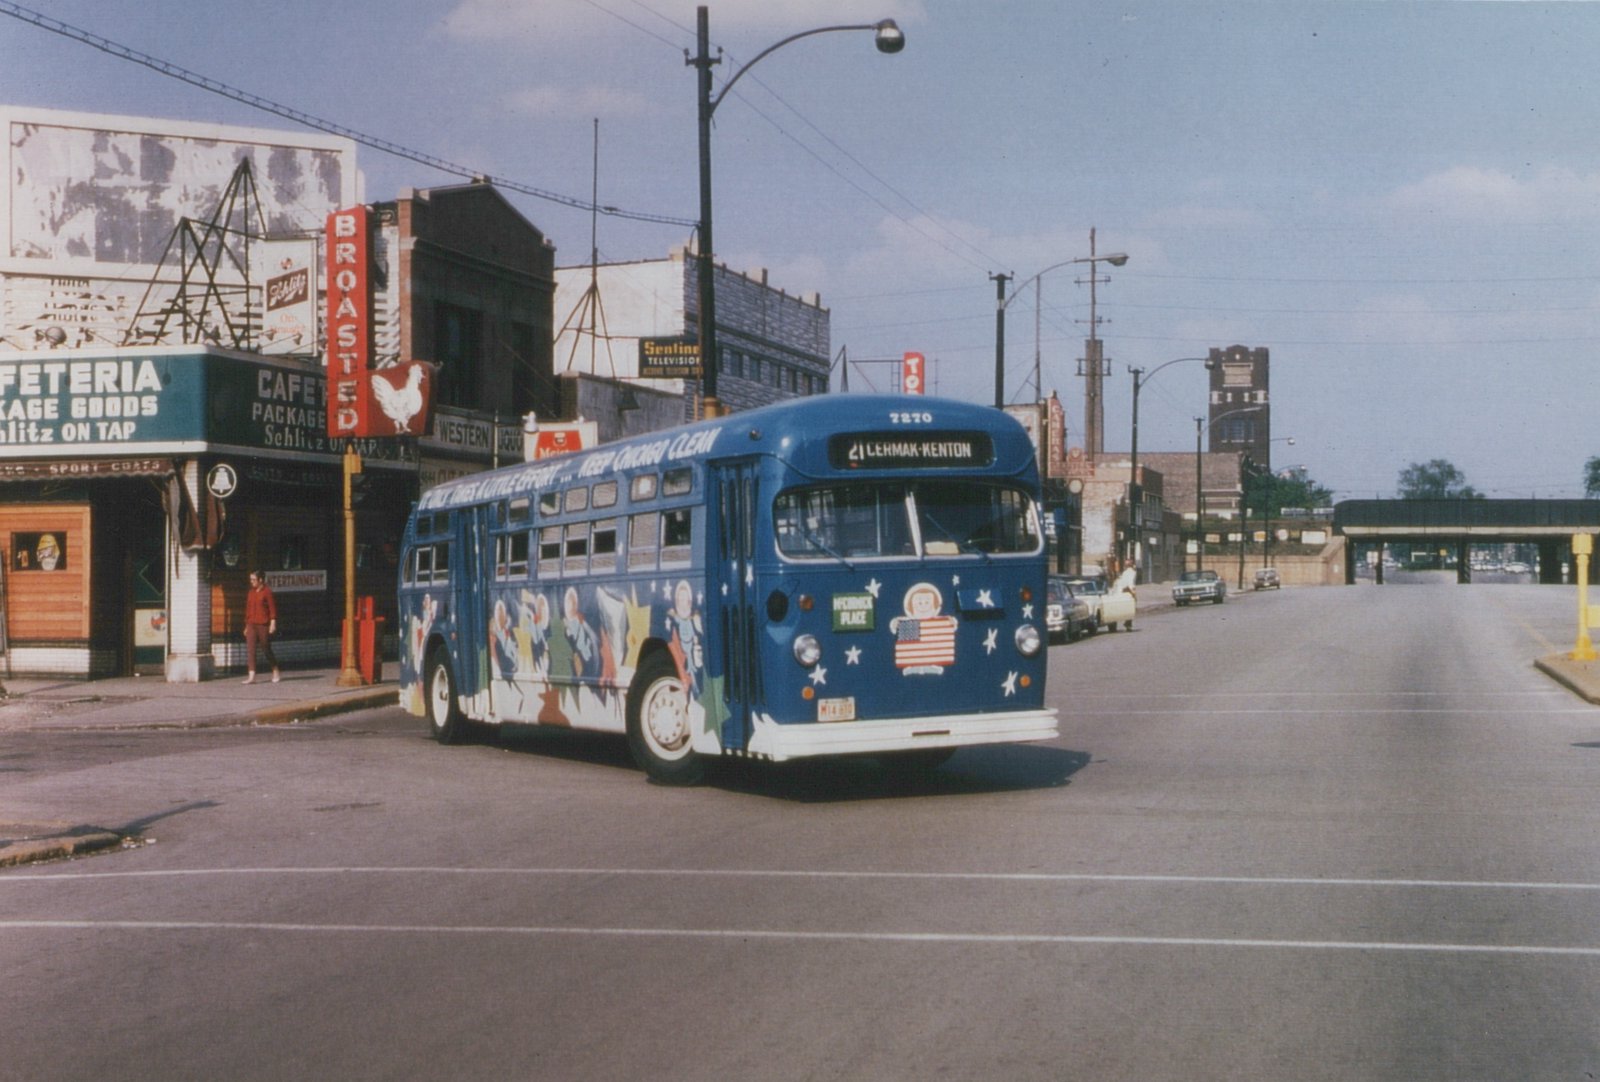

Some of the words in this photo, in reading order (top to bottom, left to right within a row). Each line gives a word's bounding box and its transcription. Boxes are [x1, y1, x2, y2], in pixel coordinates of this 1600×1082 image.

[335, 214, 359, 431] BROASTED
[71, 396, 158, 418] GOODS
[252, 402, 326, 429] PACKAGE
[62, 422, 91, 441] ON
[97, 421, 136, 441] TAP
[264, 424, 324, 450] Schlitz
[439, 421, 489, 449] WESTERN
[578, 451, 616, 478] KEEP
[613, 439, 671, 472] CHICAGO
[667, 427, 722, 461] CLEAN
[50, 463, 98, 475] SPORT
[111, 460, 160, 472] COATS
[840, 610, 867, 625] PLACE
